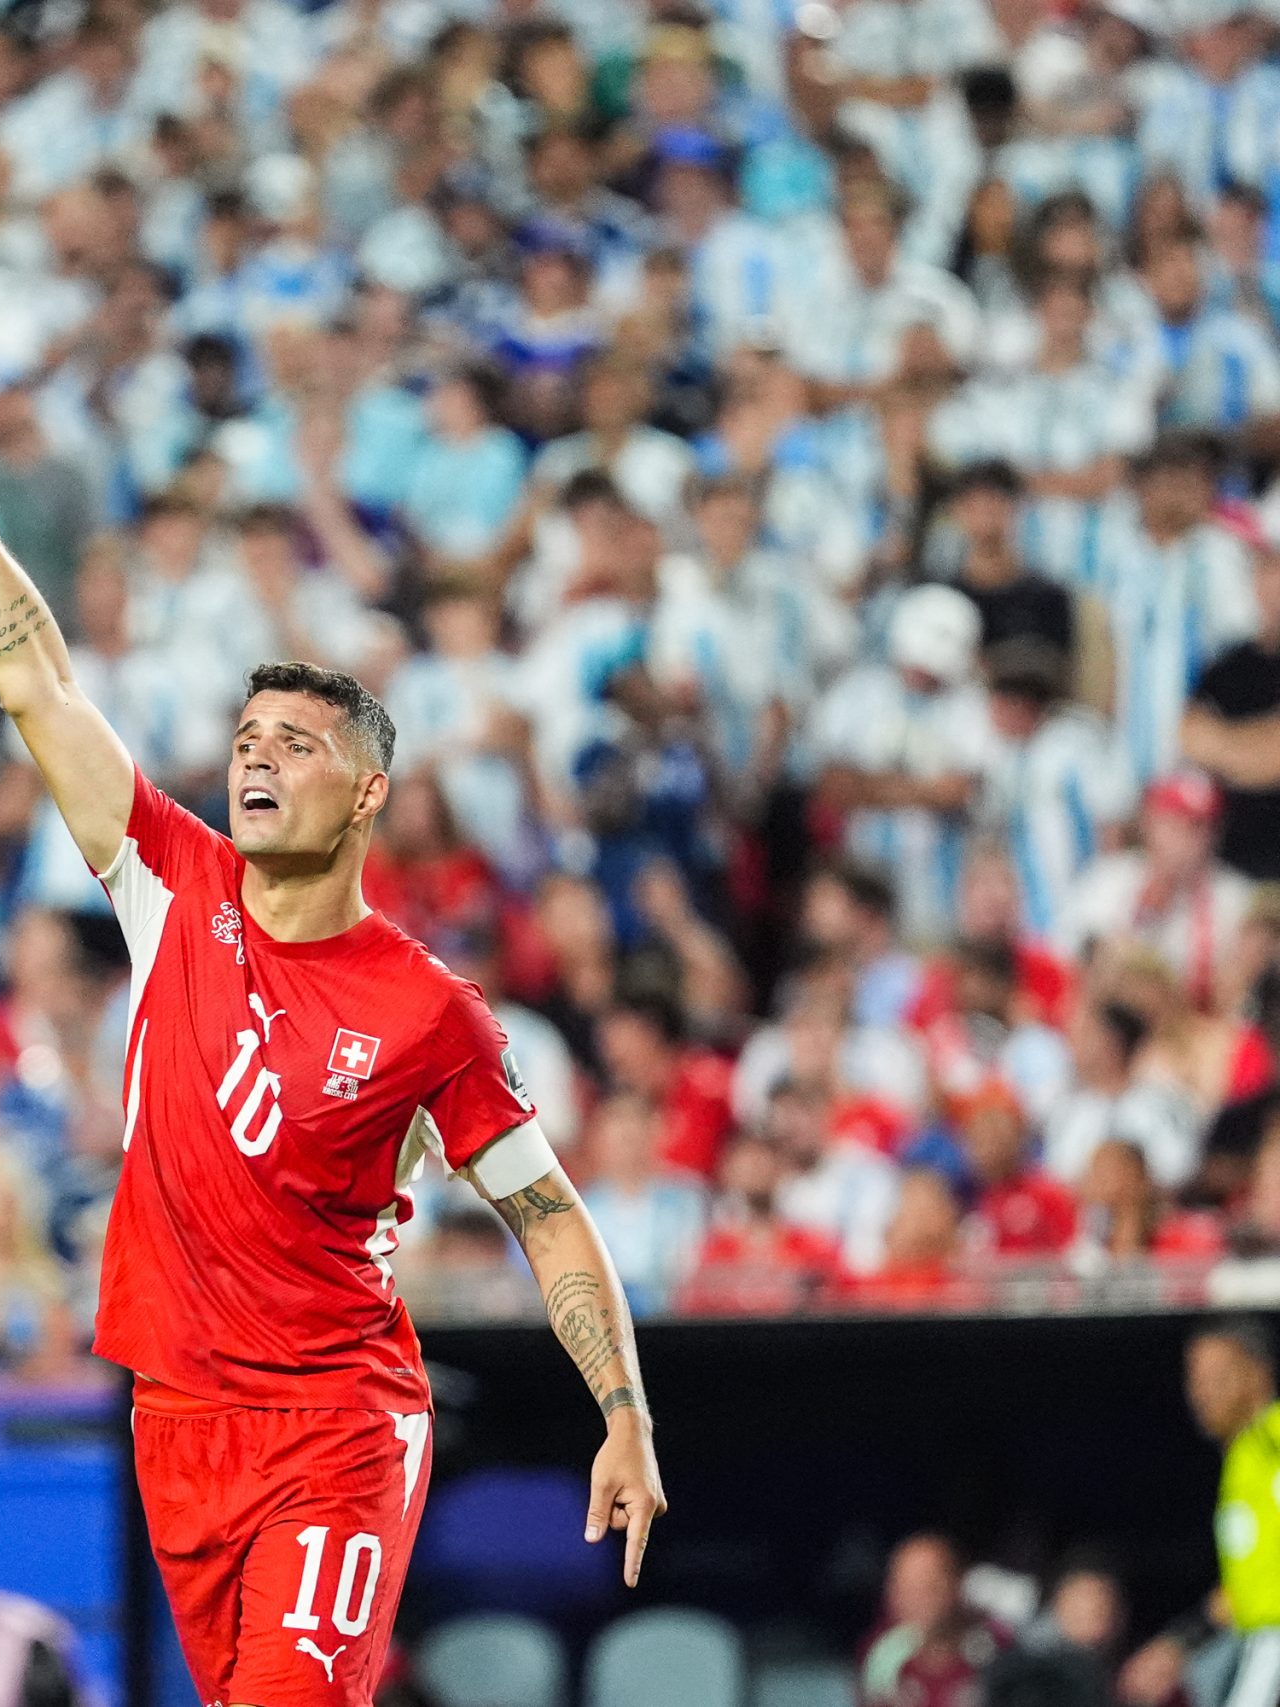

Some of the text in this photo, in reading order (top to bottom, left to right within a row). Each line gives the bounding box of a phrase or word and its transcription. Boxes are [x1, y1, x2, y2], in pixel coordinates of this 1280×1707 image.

[216, 1029, 283, 1157] 10
[343, 1092, 358, 1101] CITY
[282, 1525, 382, 1637] 10
